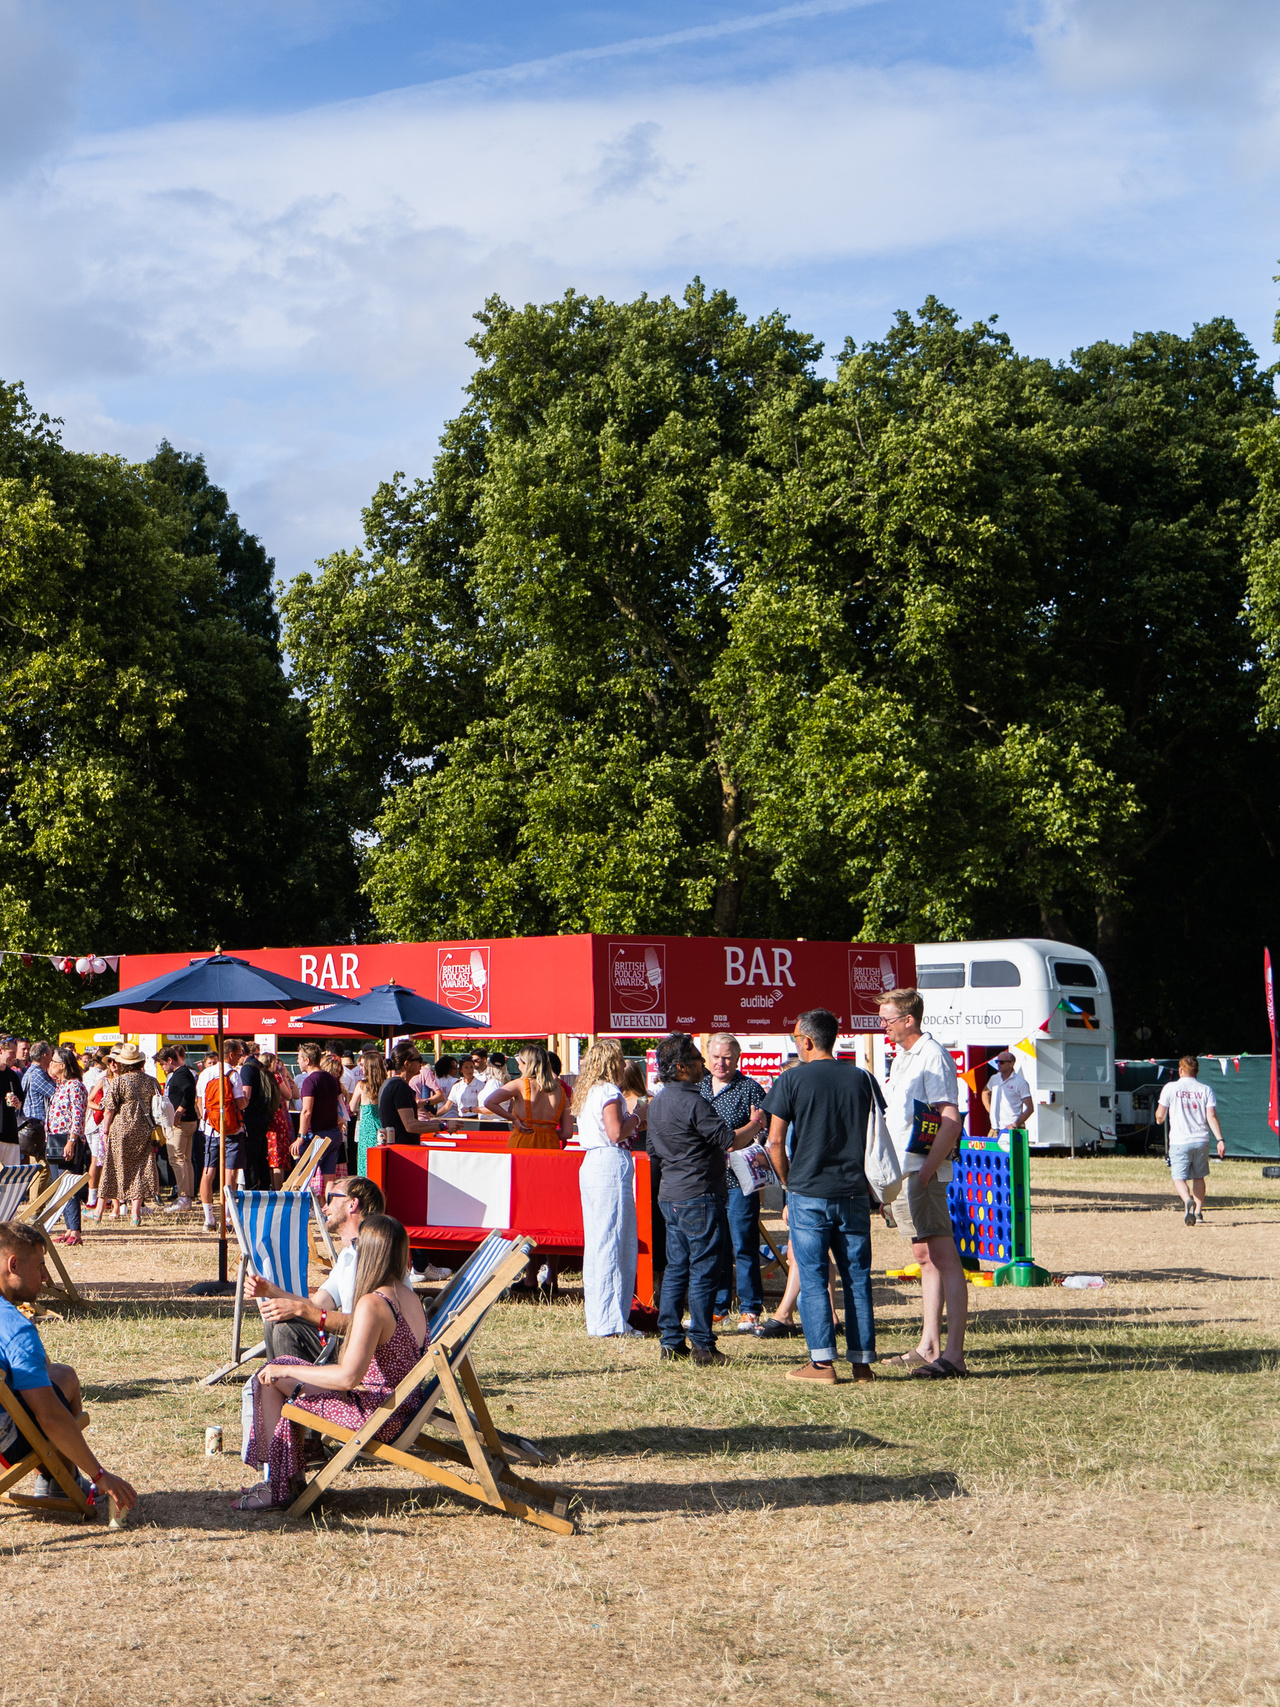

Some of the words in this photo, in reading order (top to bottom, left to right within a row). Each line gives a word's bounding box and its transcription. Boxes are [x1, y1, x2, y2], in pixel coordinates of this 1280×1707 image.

[442, 965, 471, 974] BRITISH
[614, 961, 645, 971] BRITISH
[723, 946, 796, 987] BAR
[299, 953, 361, 989] BAR
[614, 970, 646, 978] PODCAST
[853, 967, 881, 976] BRITISH
[442, 973, 471, 981] PODCAST
[853, 975, 881, 983] PODCAST
[442, 980, 470, 988] AWARDS
[614, 978, 645, 986] AWARDS
[854, 982, 880, 991] AWARDS
[740, 995, 774, 1008] audible
[191, 1017, 227, 1026] WEEKED
[612, 1015, 665, 1027] WEEKEND
[852, 1017, 881, 1027] WEEK
[923, 1015, 961, 1025] ODCAST
[965, 1015, 1002, 1025] STUDIO
[742, 1056, 781, 1068] podpod
[1175, 1091, 1203, 1099] CREW
